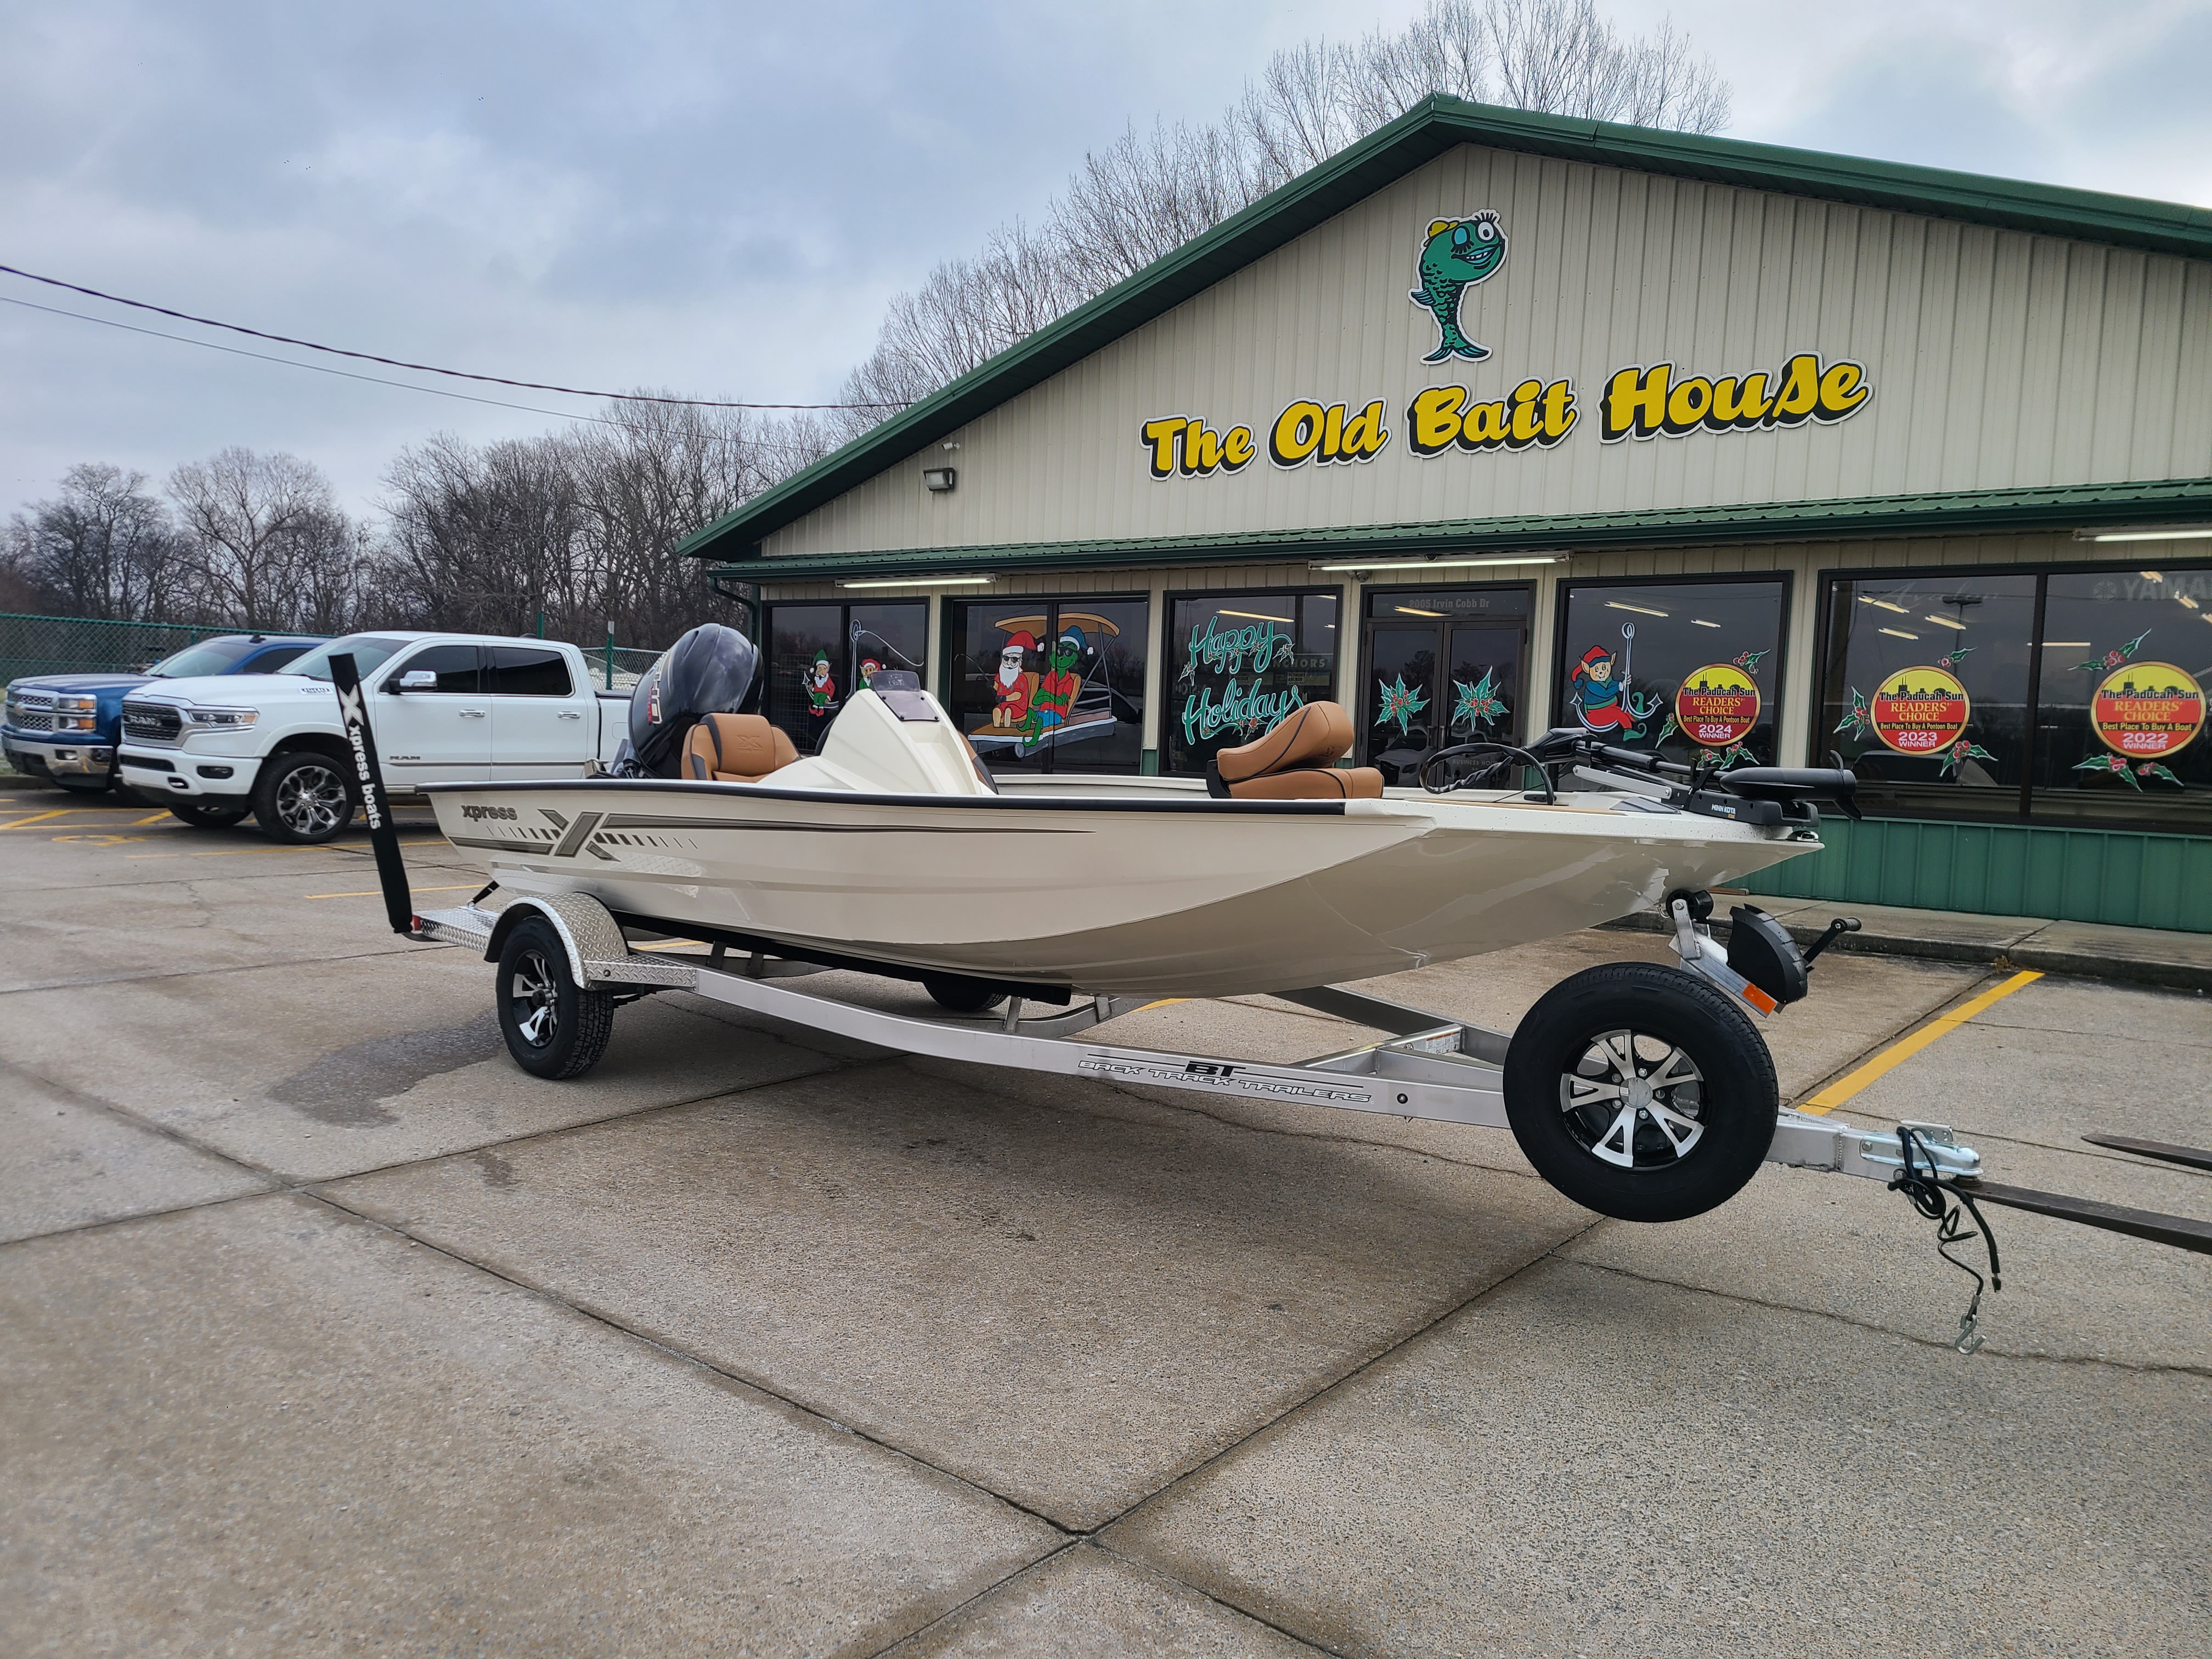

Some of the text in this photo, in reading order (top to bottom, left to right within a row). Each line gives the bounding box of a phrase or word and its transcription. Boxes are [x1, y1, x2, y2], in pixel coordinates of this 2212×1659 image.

[1141, 352, 1870, 479] The Old Bait House
[2123, 576, 2212, 600] YAMA
[1408, 598, 1490, 608] 2005 Irvin Cobb Dr
[1188, 616, 1293, 674] Happy
[1683, 686, 1756, 696] The Paducah Sun
[1879, 691, 1963, 701] The Paducah Sun
[2101, 689, 2199, 699] The Paducah Sun
[1182, 678, 1304, 745] Holidays
[1700, 706, 1734, 715] CHOICE
[1899, 712, 1939, 721] CHOICE
[2124, 712, 2171, 721] CHOICE
[1699, 724, 1732, 733] 2024
[2102, 722, 2118, 730] Best
[2151, 723, 2166, 732] Buy
[1898, 732, 1937, 741] 2023
[2122, 732, 2169, 743] 2022
[348, 725, 382, 830] xpress boats
[461, 805, 517, 822] xpress
[1711, 803, 1736, 815] MINN KOTA
[1185, 1061, 1246, 1077] BT
[1078, 1060, 1372, 1103] BACK TRACK TRAILERS
